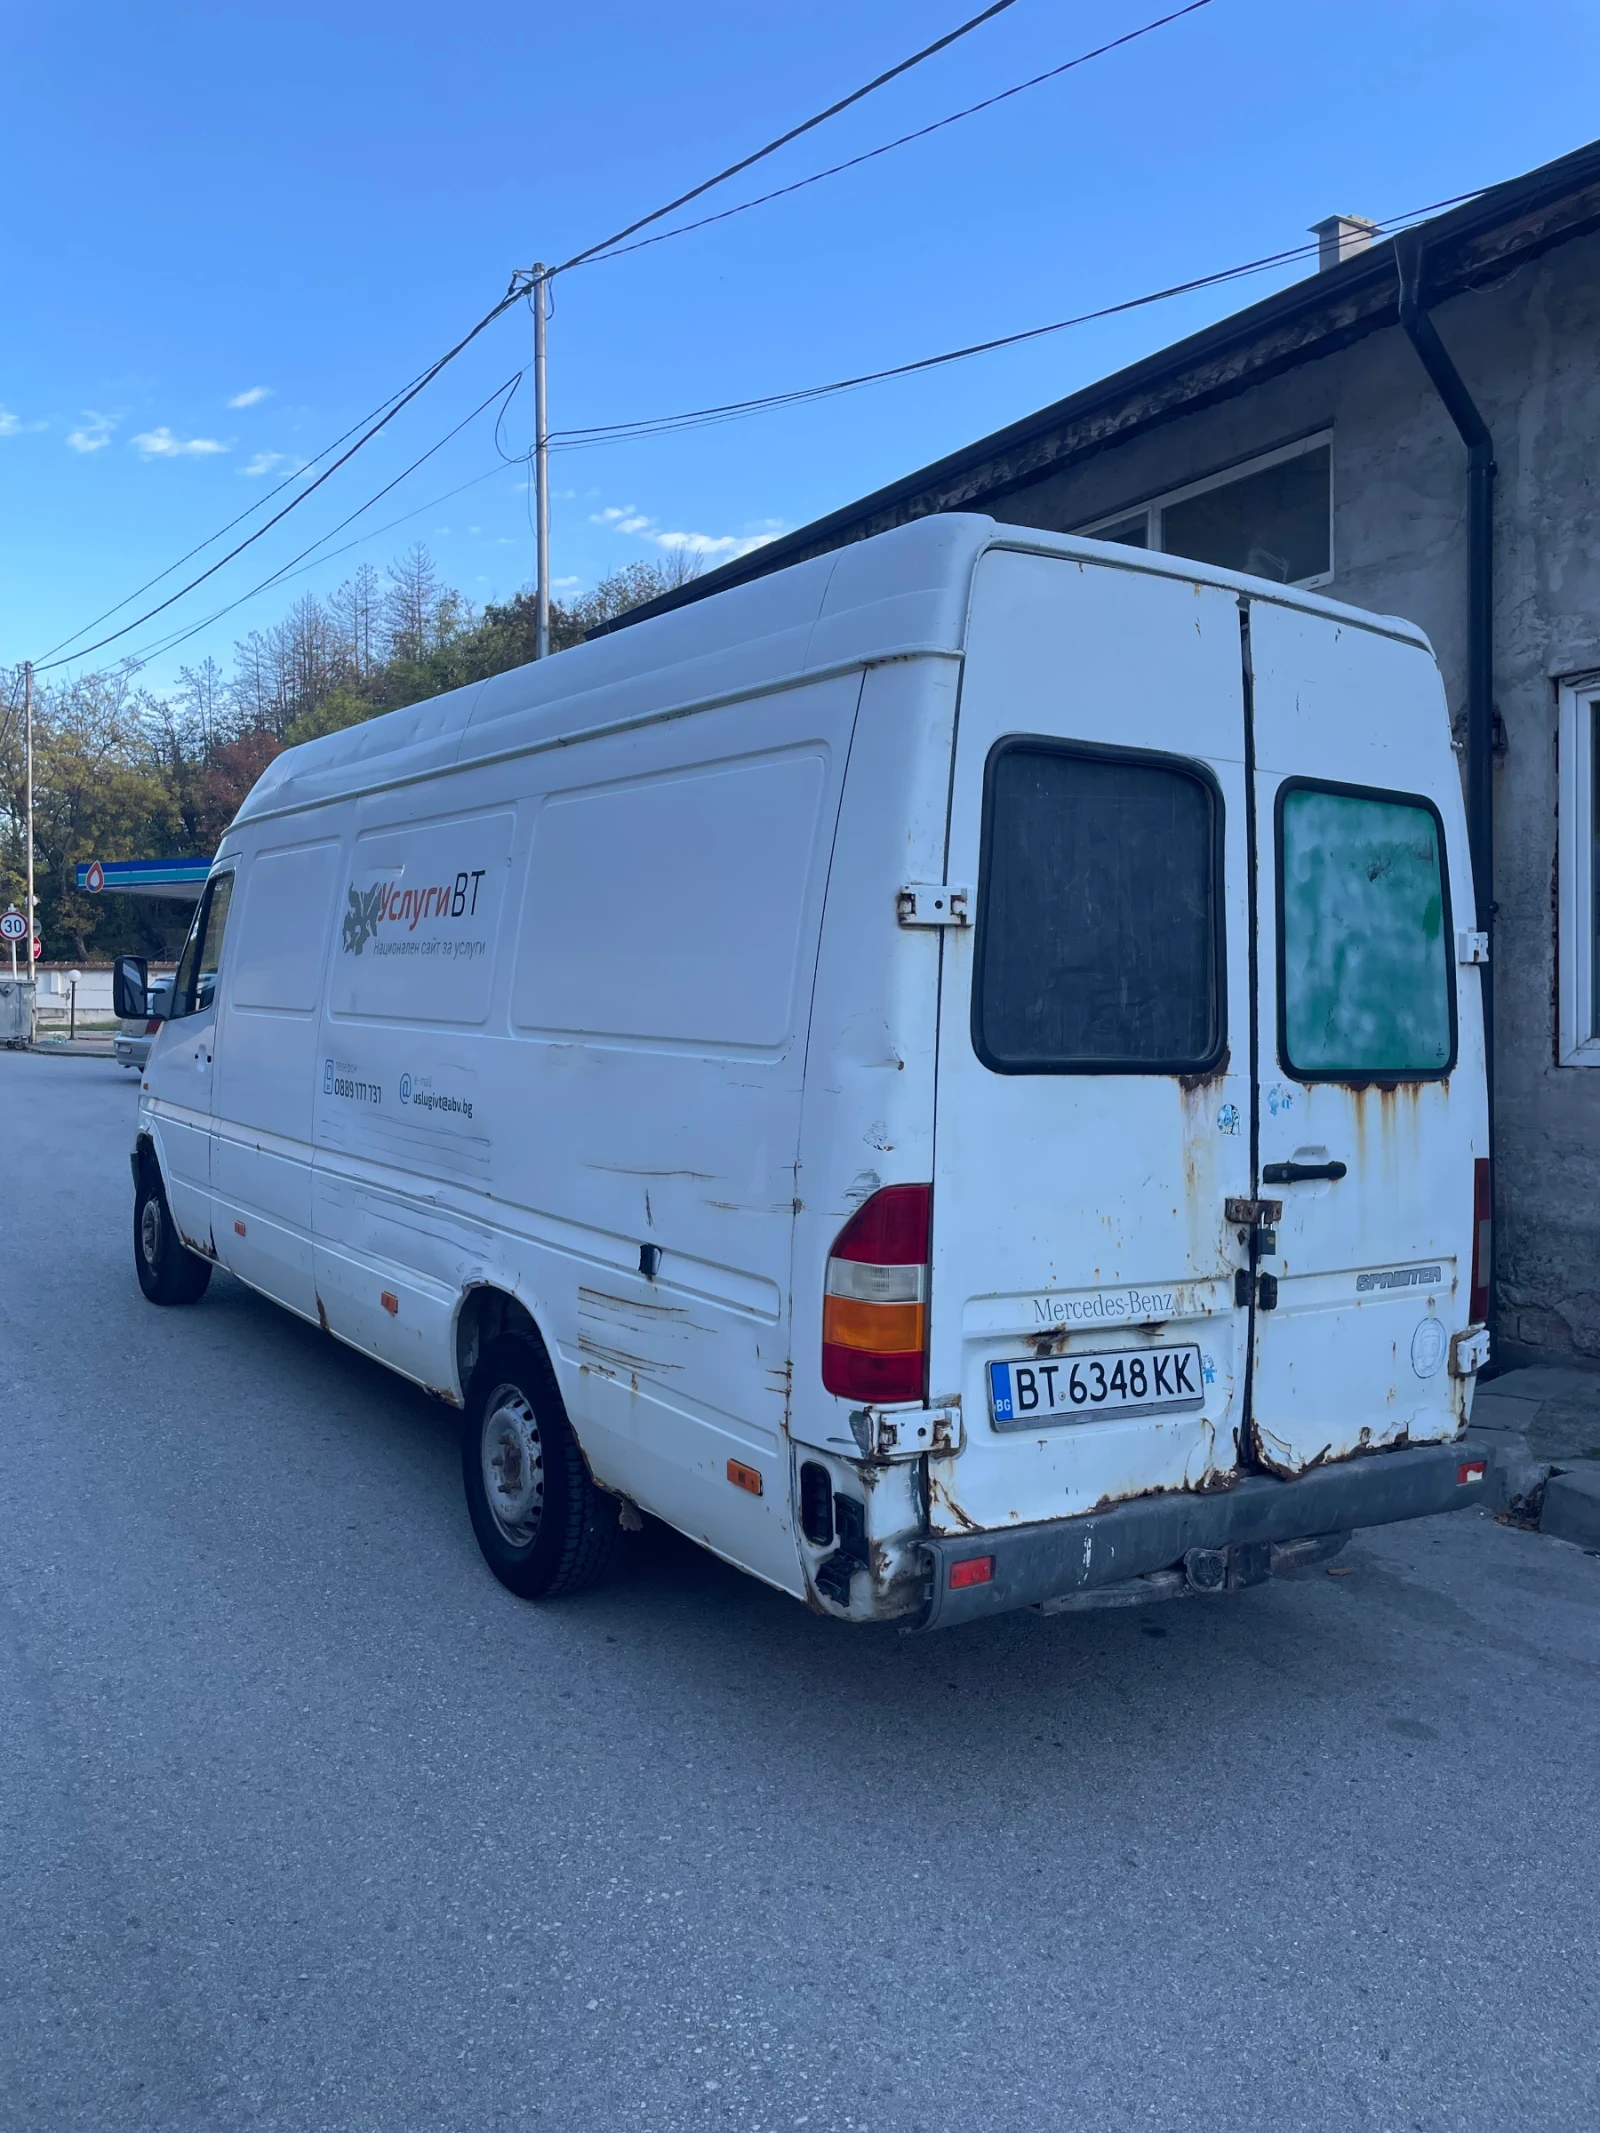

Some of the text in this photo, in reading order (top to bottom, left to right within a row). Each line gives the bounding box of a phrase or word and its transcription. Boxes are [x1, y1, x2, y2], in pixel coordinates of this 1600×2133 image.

[4, 919, 22, 933] 30
[373, 937, 486, 960] Национален сайт за услуги
[334, 1078, 354, 1098] 0889
[414, 1076, 432, 1088] e-mail
[413, 1090, 473, 1119] uslugivt@abv.bg
[1356, 1266, 1442, 1292] SPRINTER
[1033, 1290, 1174, 1323] Mercedes-Benz
[1016, 1353, 1196, 1411] BT 6348 KK
[996, 1399, 1012, 1412] BG
